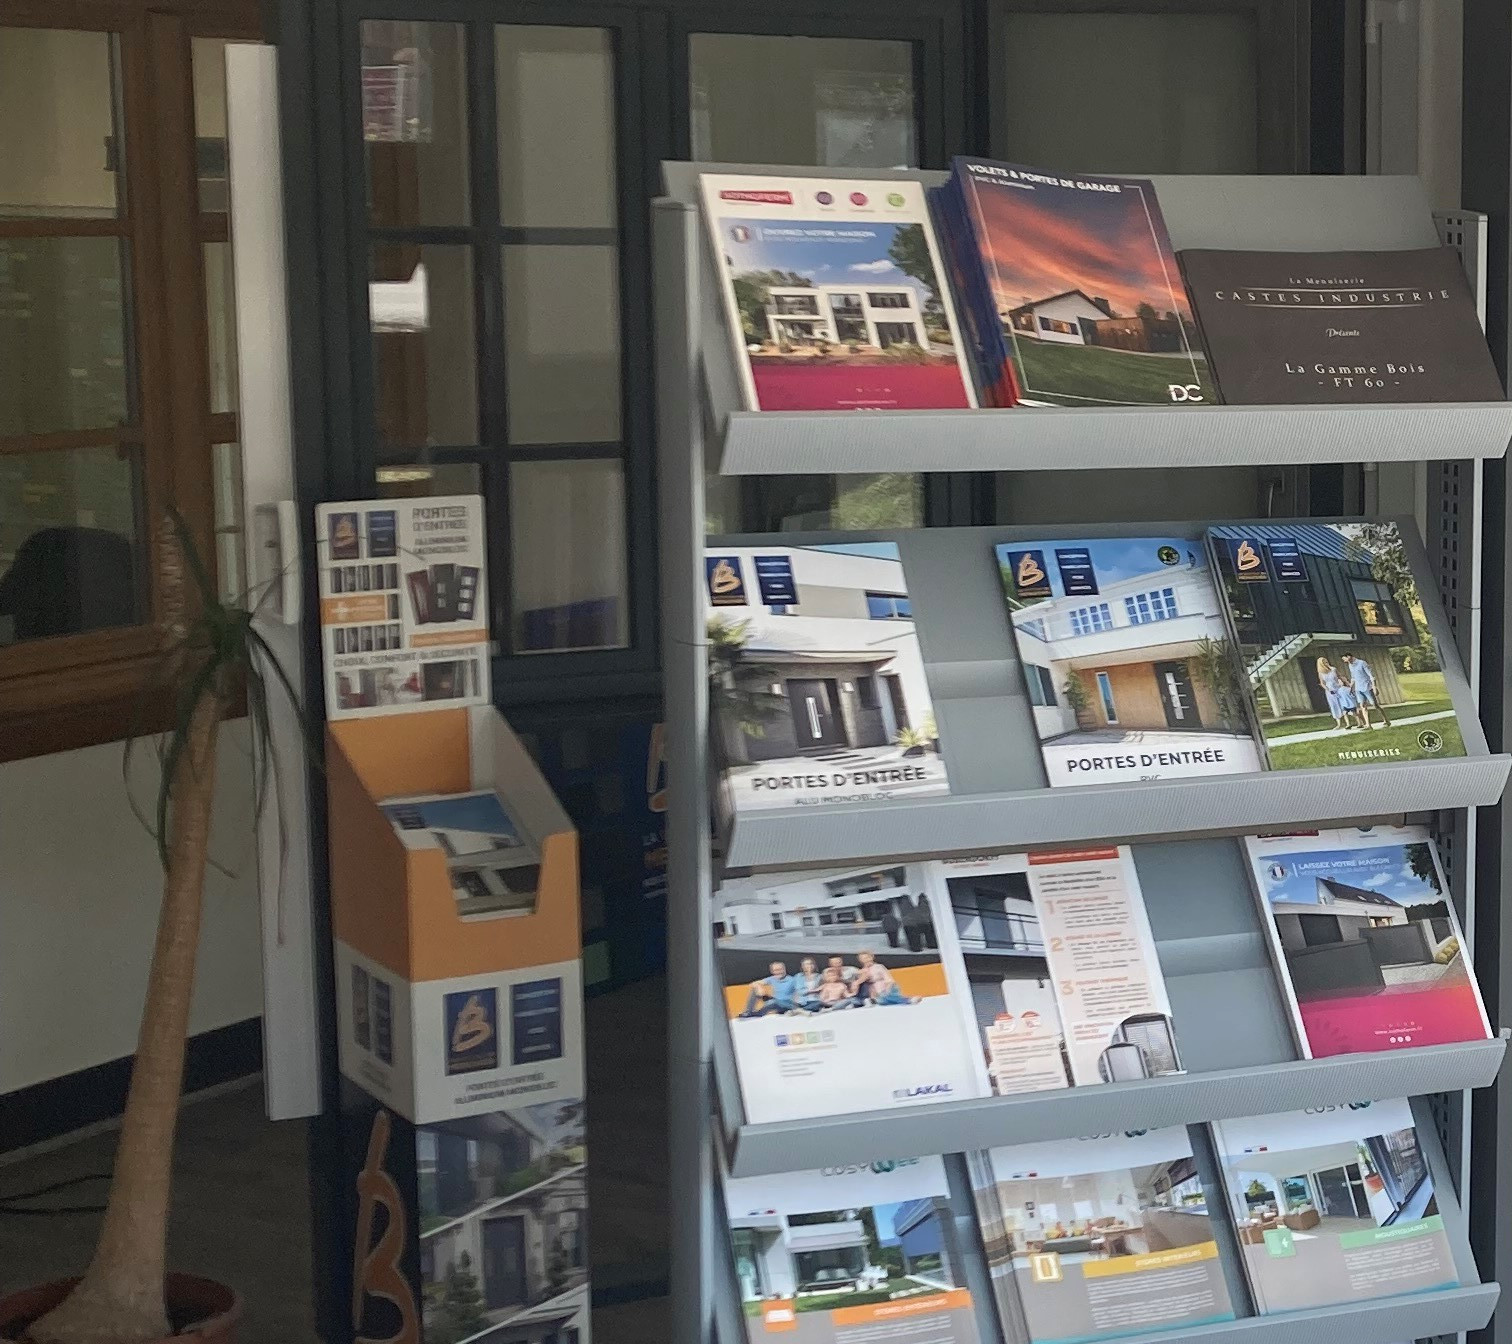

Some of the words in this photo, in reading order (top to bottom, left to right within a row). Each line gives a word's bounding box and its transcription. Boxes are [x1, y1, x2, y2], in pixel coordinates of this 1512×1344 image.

[966, 164, 1008, 177] VOLETS
[1010, 170, 1018, 179] &
[1019, 172, 1058, 186] PORTES
[1060, 179, 1075, 189] DE
[1076, 181, 1121, 193] GARAGE
[1289, 277, 1302, 285] La
[1215, 290, 1301, 303] CASTES
[1319, 289, 1450, 304] INDUSTRIE
[1285, 362, 1305, 374] La
[1315, 363, 1378, 375] Gamme
[1386, 362, 1426, 374] Bois
[1334, 377, 1354, 387] FT
[1168, 384, 1204, 402] DC
[1068, 755, 1137, 773] PORTES
[1140, 748, 1226, 768] D'ENTRÉE
[752, 774, 828, 791] PORTES
[834, 765, 927, 787] D'ENTRÉE
[908, 1083, 953, 1097] LAKAL
